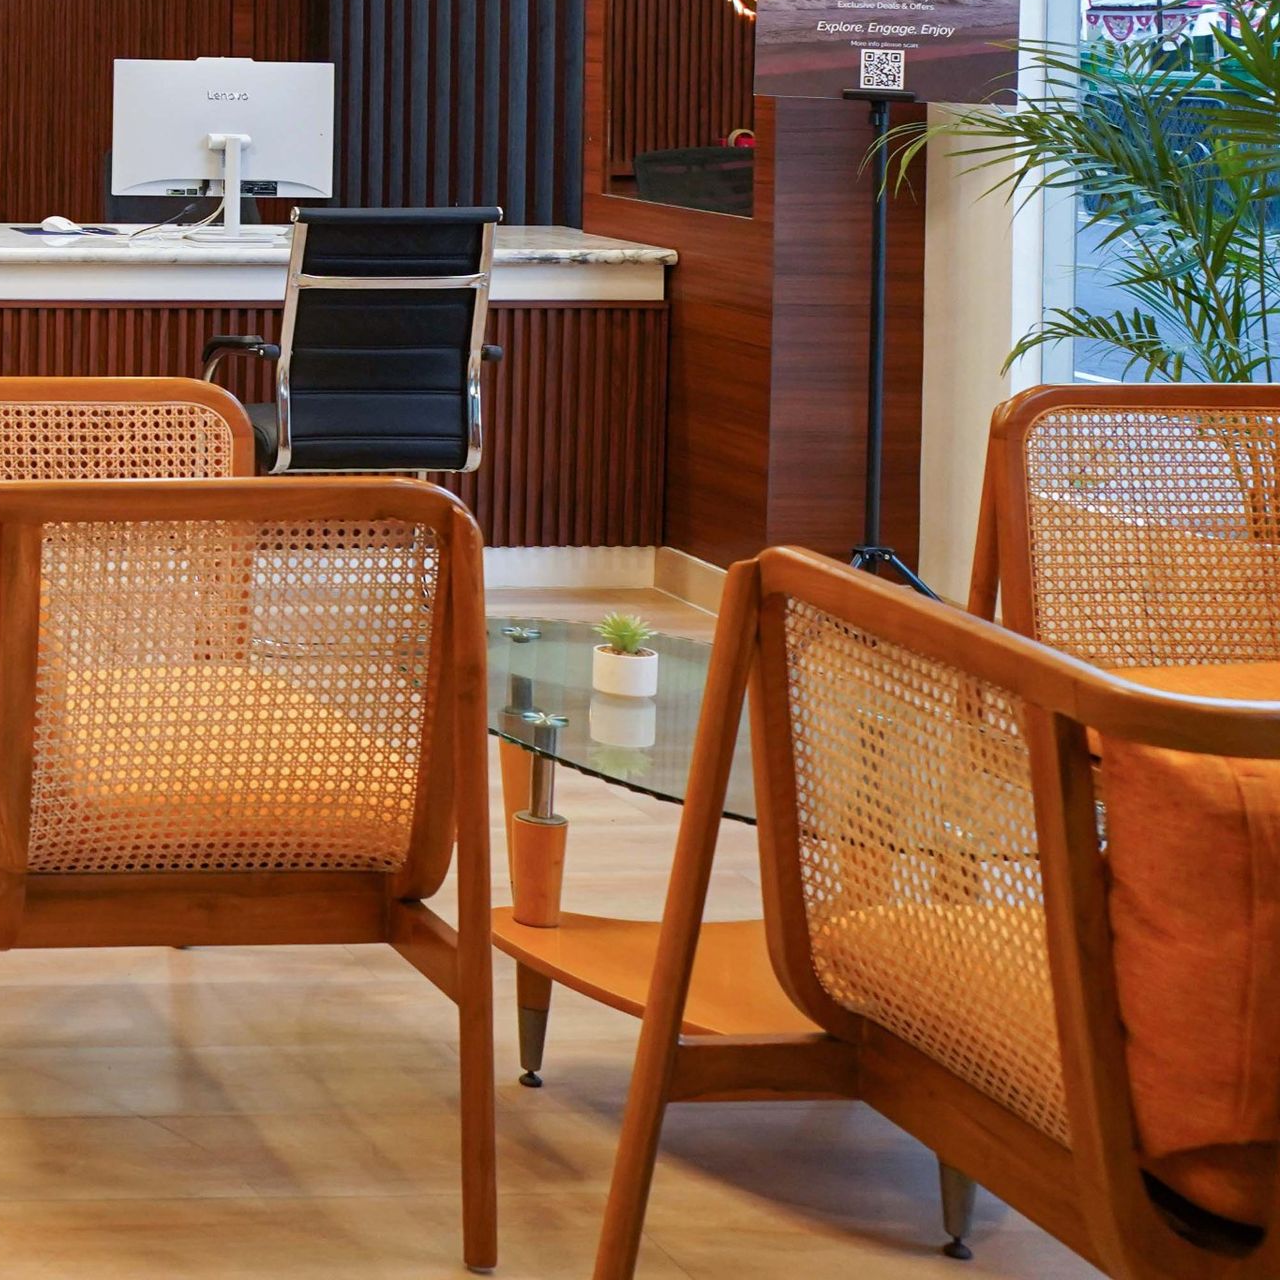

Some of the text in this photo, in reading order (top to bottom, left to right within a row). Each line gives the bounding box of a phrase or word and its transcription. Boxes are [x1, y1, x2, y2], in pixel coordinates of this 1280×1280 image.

[837, 1, 876, 9] Exclusive
[876, 2, 901, 10] Deals
[909, 2, 936, 11] Offers
[920, 24, 955, 37] Enjoy
[207, 90, 249, 101] Lenovo
